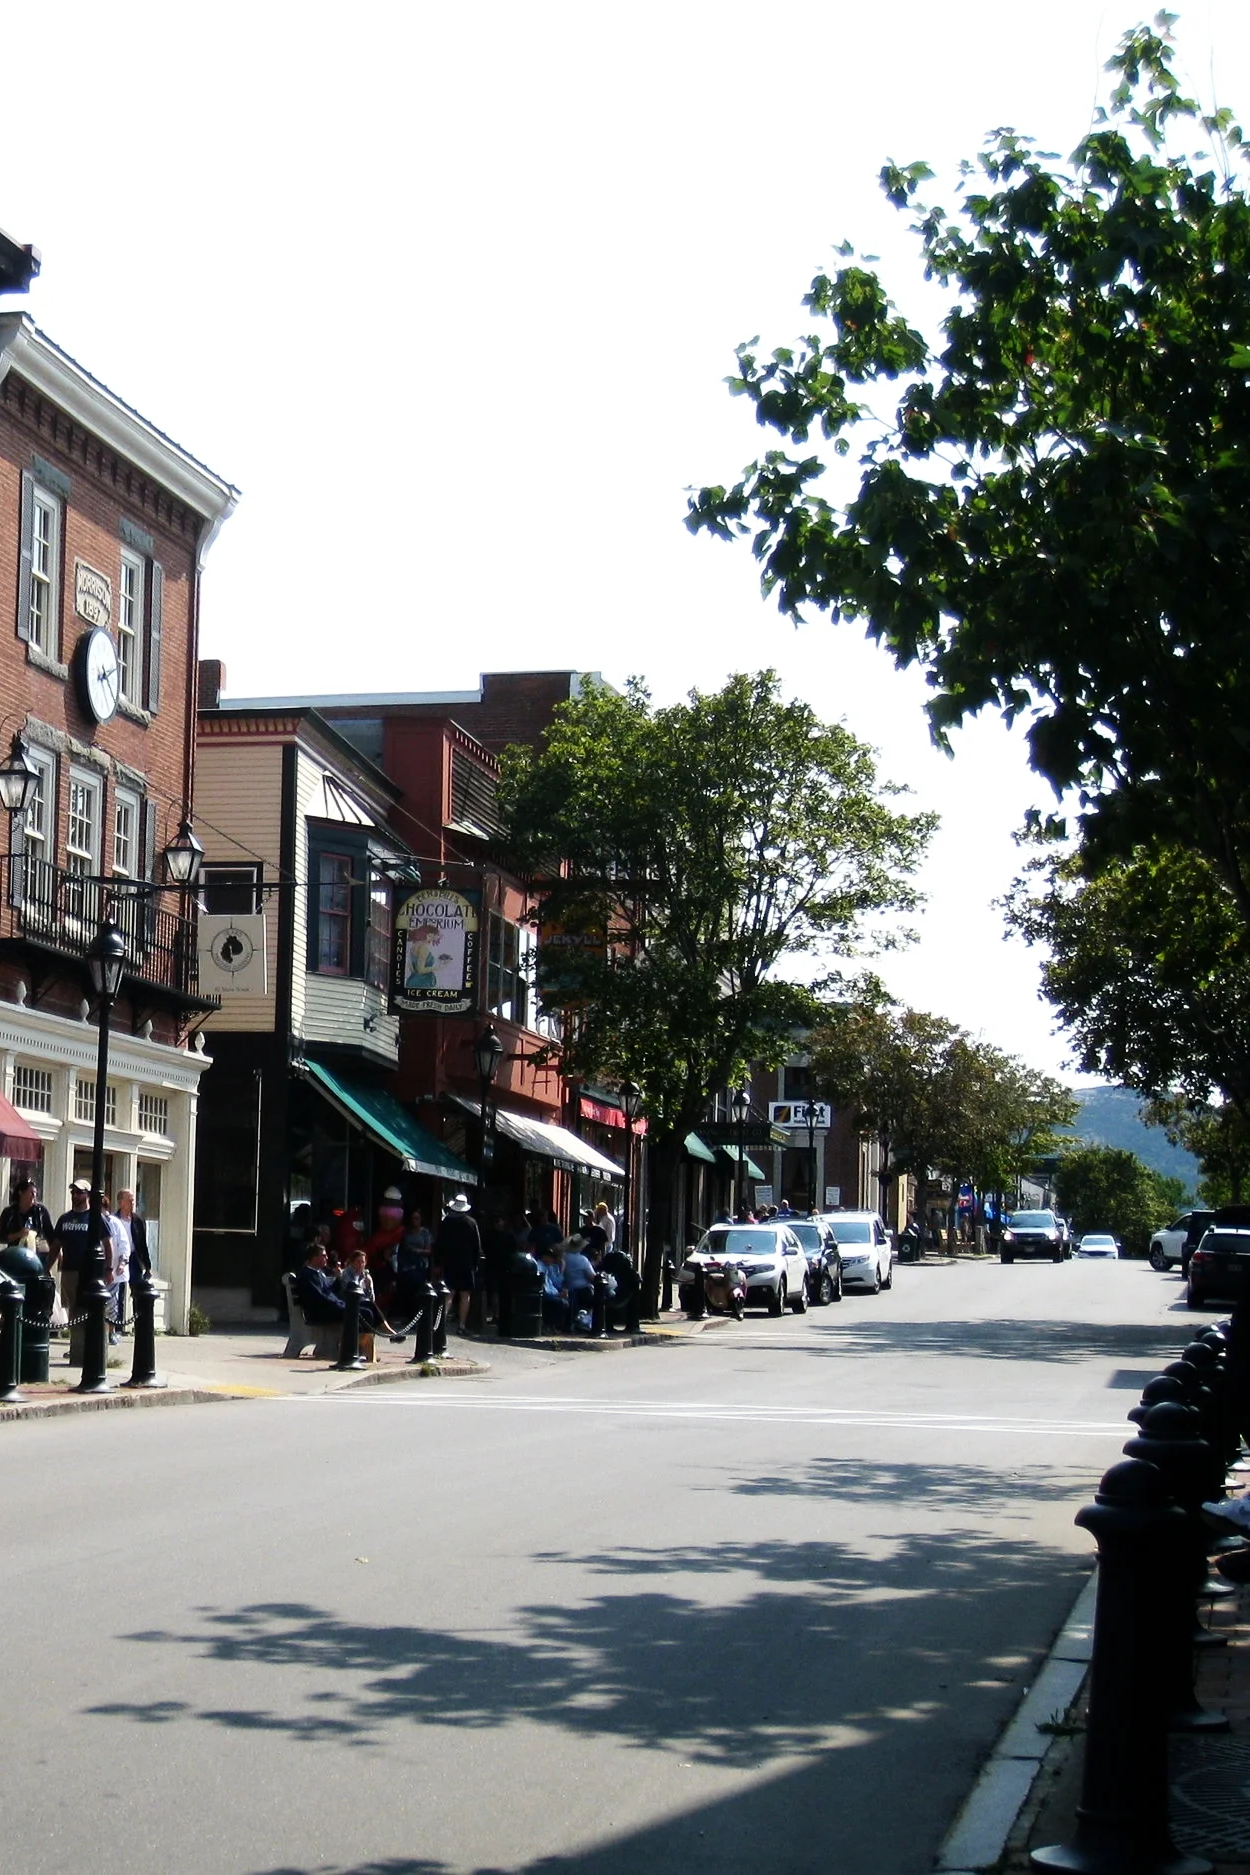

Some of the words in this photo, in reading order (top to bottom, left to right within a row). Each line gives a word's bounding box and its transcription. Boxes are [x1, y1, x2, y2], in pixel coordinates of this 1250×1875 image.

[409, 917, 464, 930] EMPORIUM
[544, 934, 602, 946] JEKYLL
[395, 930, 403, 985] CANDIES
[465, 933, 473, 980] COFFEE
[407, 989, 422, 997] ICE
[426, 990, 458, 998] CREAM
[793, 1105, 825, 1118] Fit
